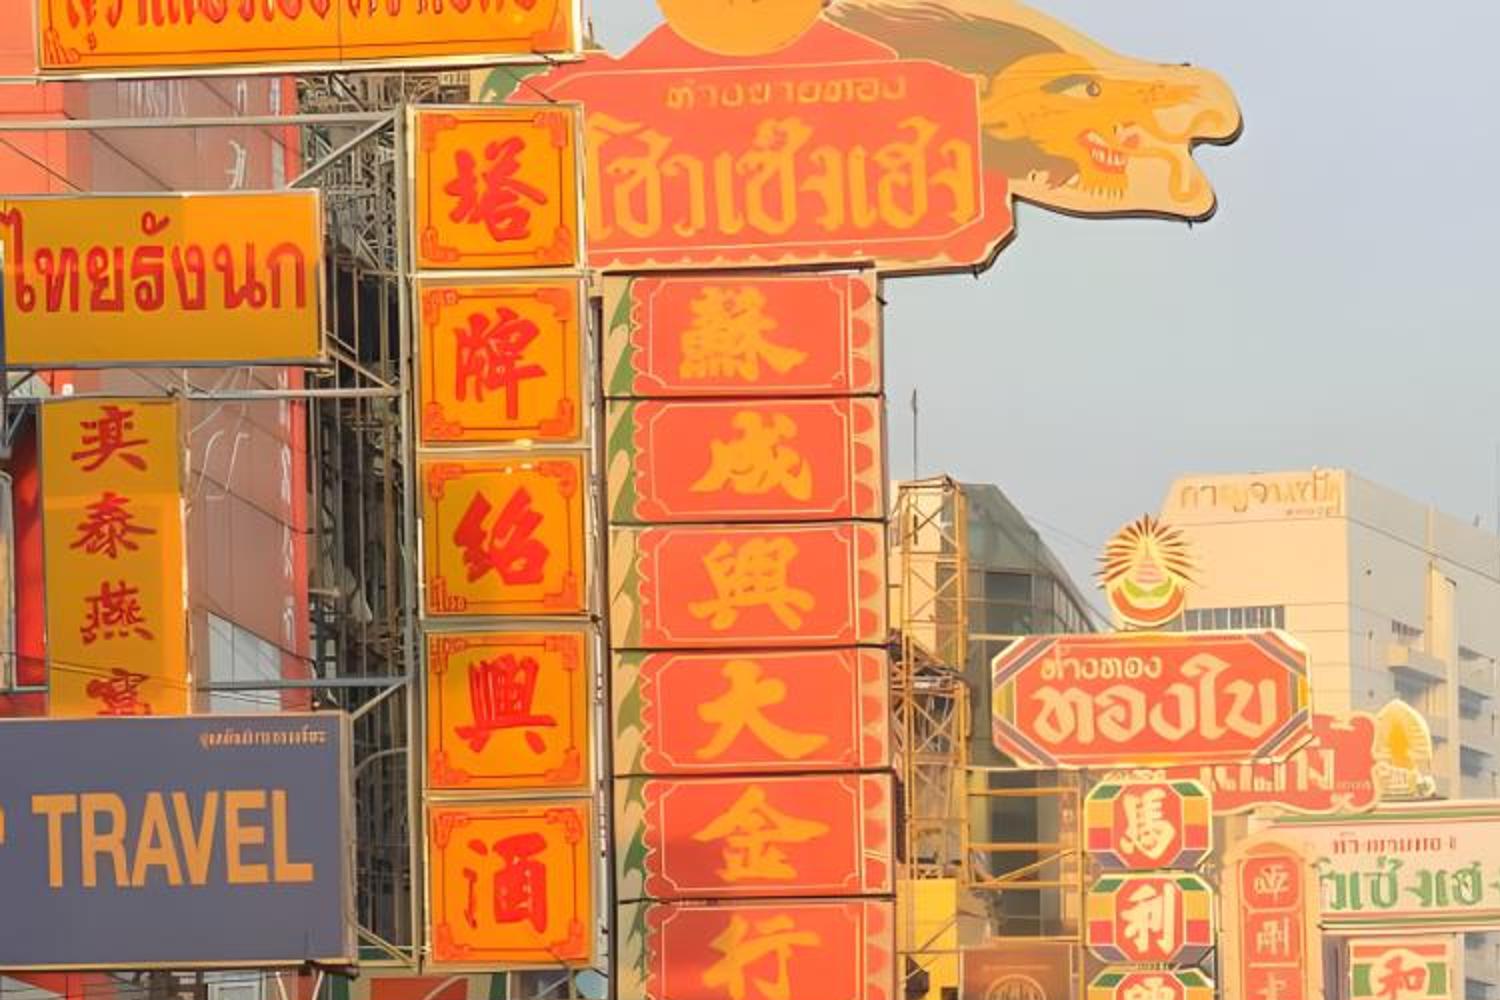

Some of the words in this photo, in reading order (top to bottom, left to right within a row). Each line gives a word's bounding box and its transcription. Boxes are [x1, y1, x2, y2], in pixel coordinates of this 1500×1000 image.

[0, 206, 306, 314] ไทยรังนก
[1030, 654, 1276, 745] ทองใบ
[31, 788, 314, 888] TRAVEL
